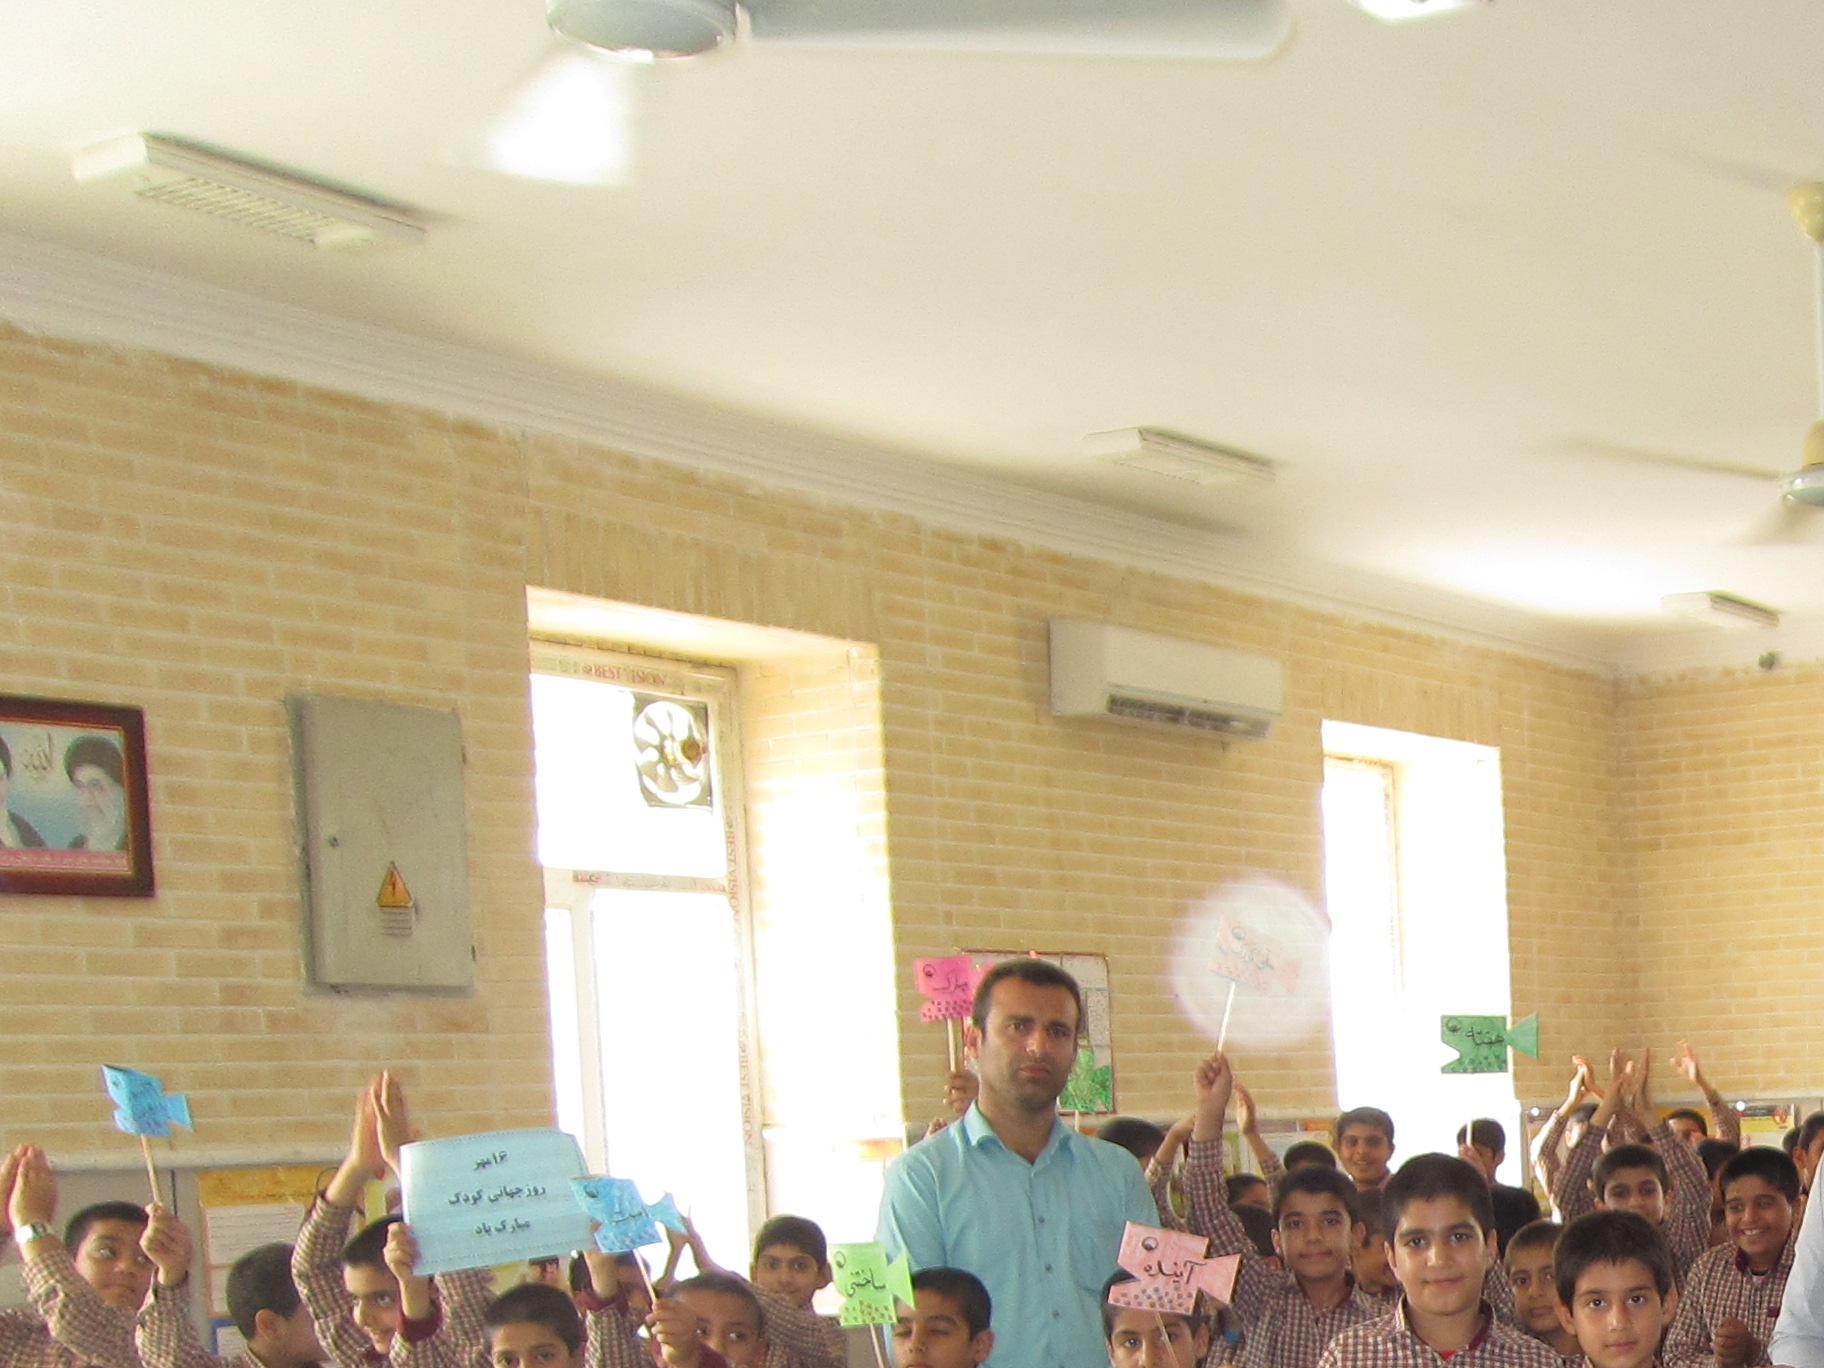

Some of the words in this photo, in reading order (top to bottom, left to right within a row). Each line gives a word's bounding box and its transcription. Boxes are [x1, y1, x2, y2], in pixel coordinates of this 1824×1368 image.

[1465, 1026, 1505, 1048] هفته
[448, 1189, 483, 1206] کودک
[525, 1184, 546, 1198] روز
[1144, 1260, 1207, 1285] آینده
